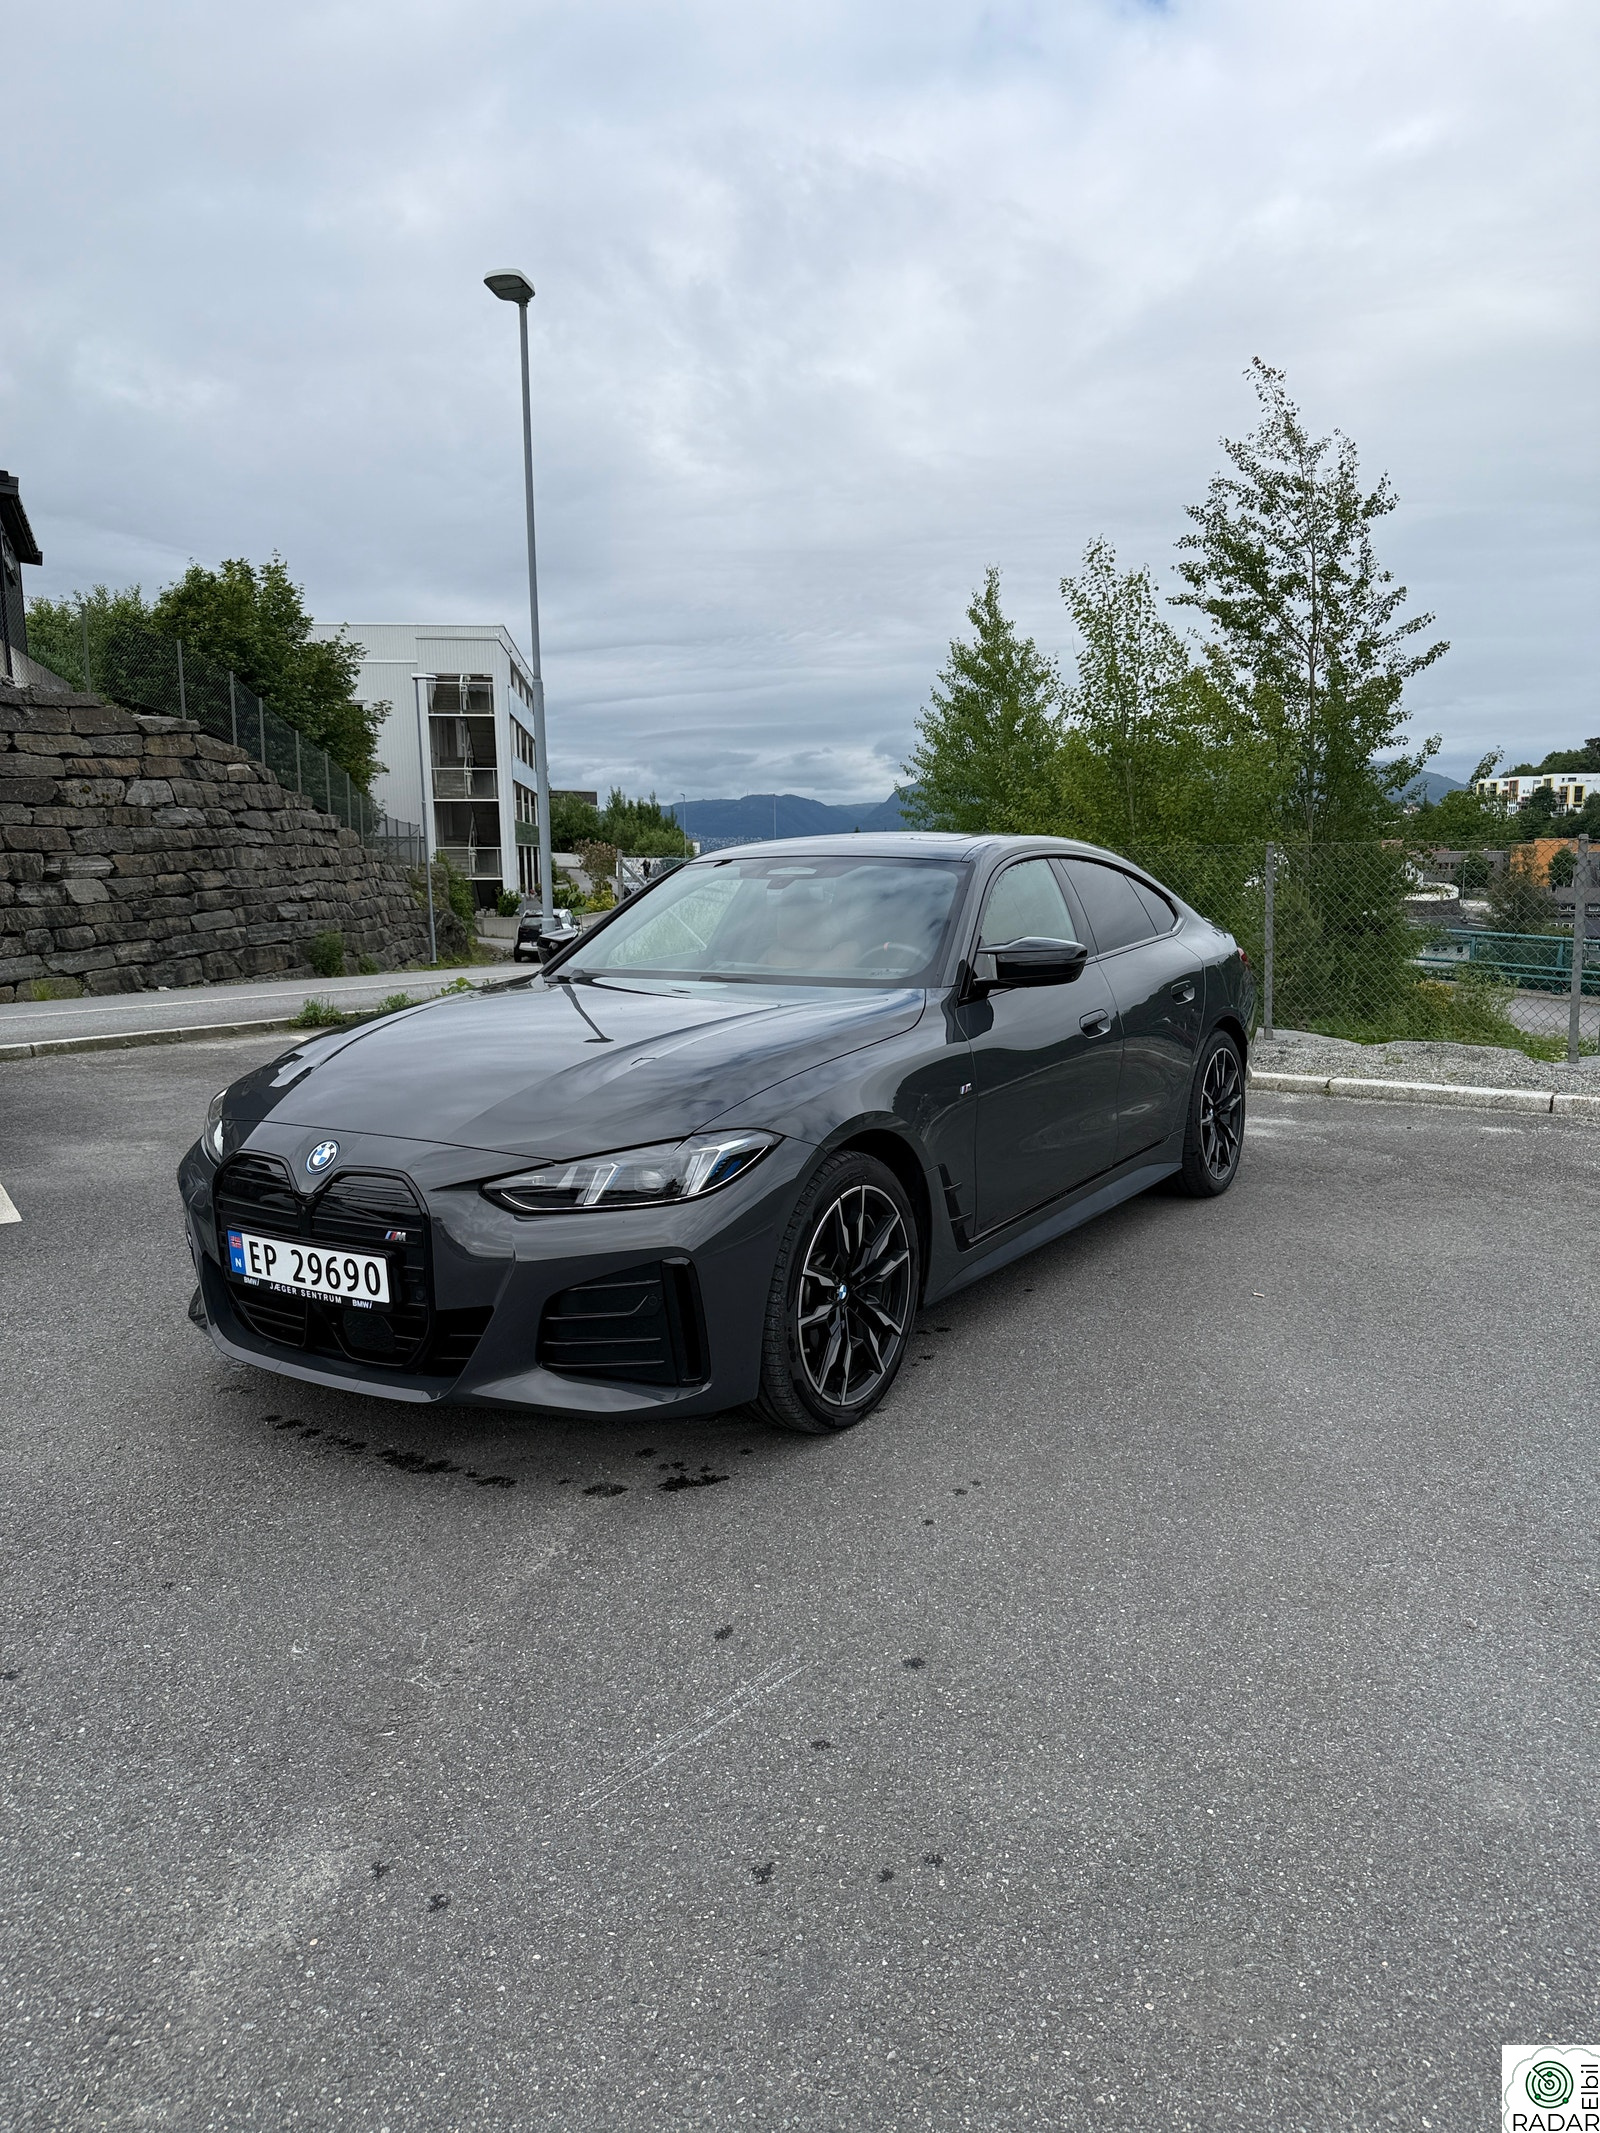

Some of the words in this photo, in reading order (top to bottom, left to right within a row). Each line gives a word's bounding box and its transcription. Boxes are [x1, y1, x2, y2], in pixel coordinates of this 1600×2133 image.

[235, 1257, 242, 1268] N
[248, 1240, 278, 1277] EP
[290, 1249, 381, 1296] 29690
[269, 1284, 297, 1295] JÆGER
[300, 1289, 342, 1304] SENTRUM
